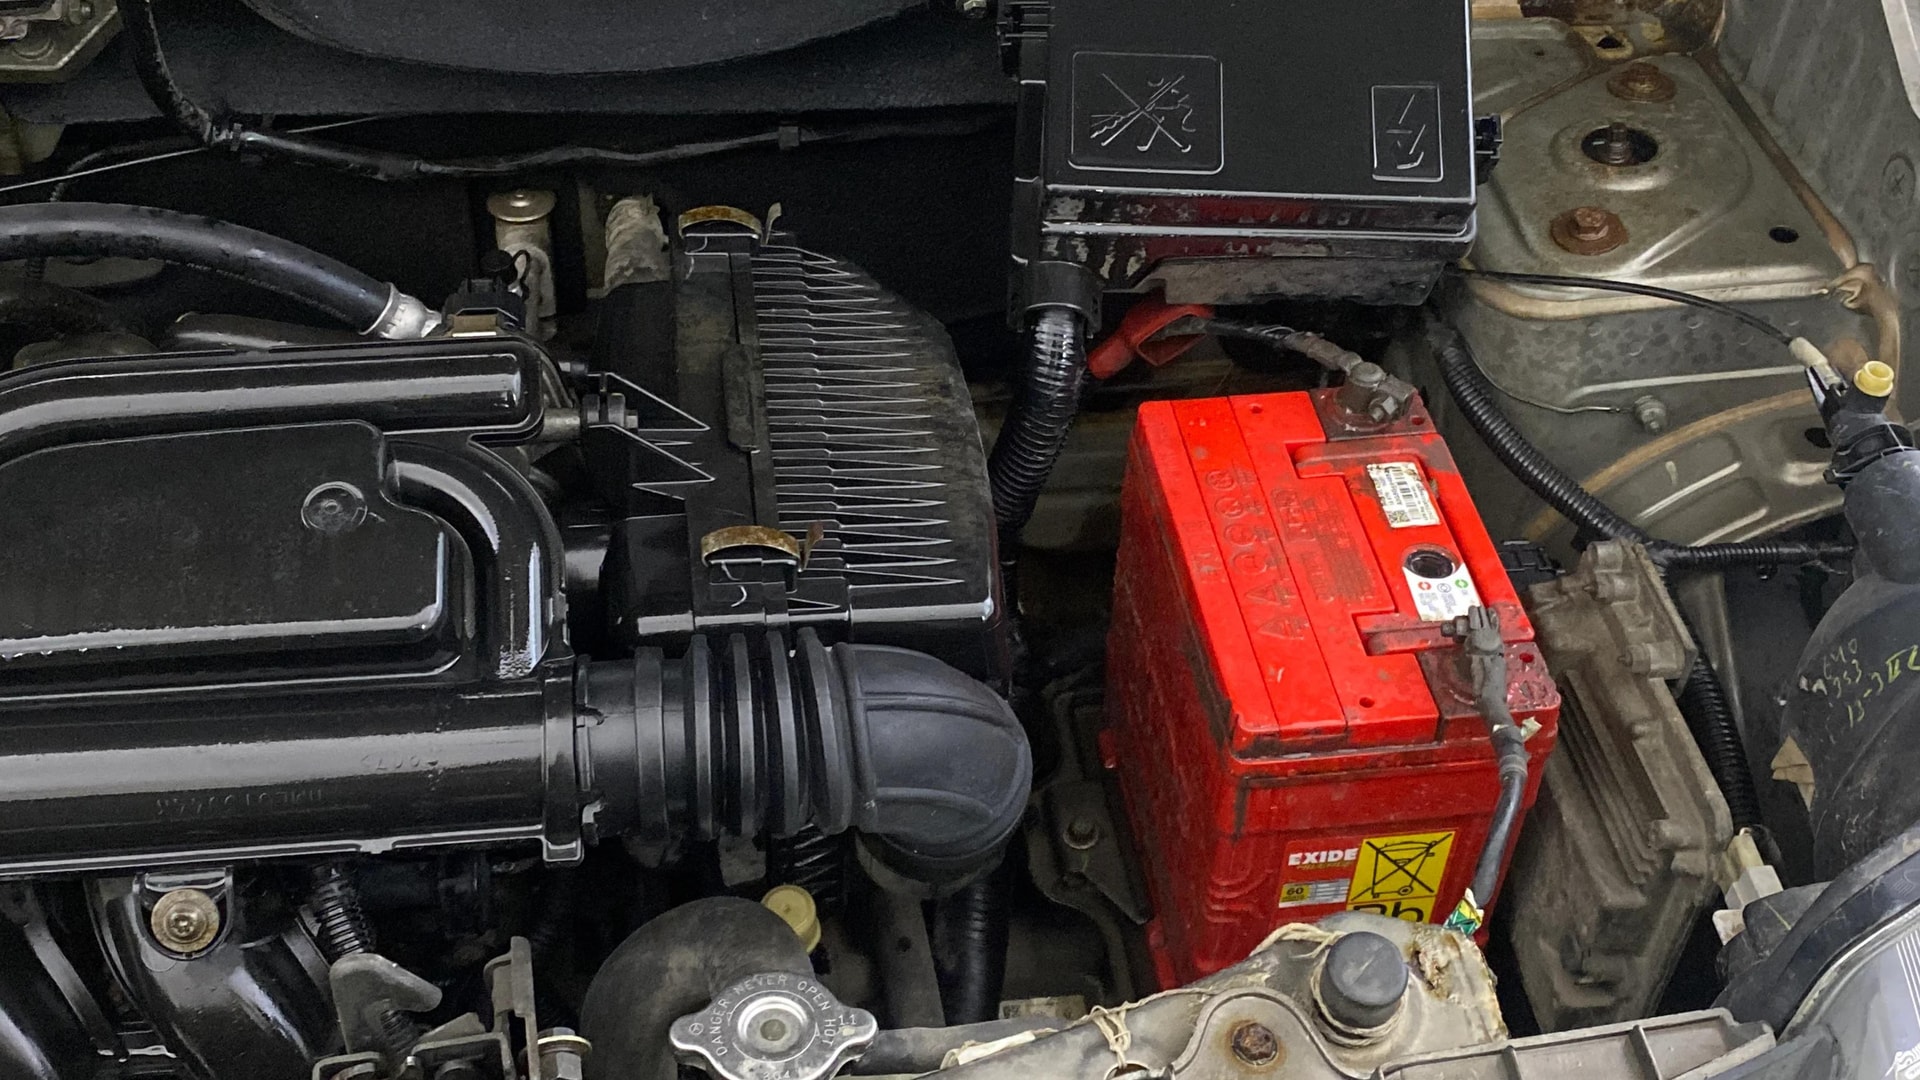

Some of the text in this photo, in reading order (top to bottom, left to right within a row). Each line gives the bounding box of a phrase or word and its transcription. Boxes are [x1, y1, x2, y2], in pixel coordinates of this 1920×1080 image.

[1288, 848, 1359, 866] EXIDE
[1286, 887, 1304, 896] 60
[709, 974, 837, 1056] DANGER NEVER OPEN HOT
